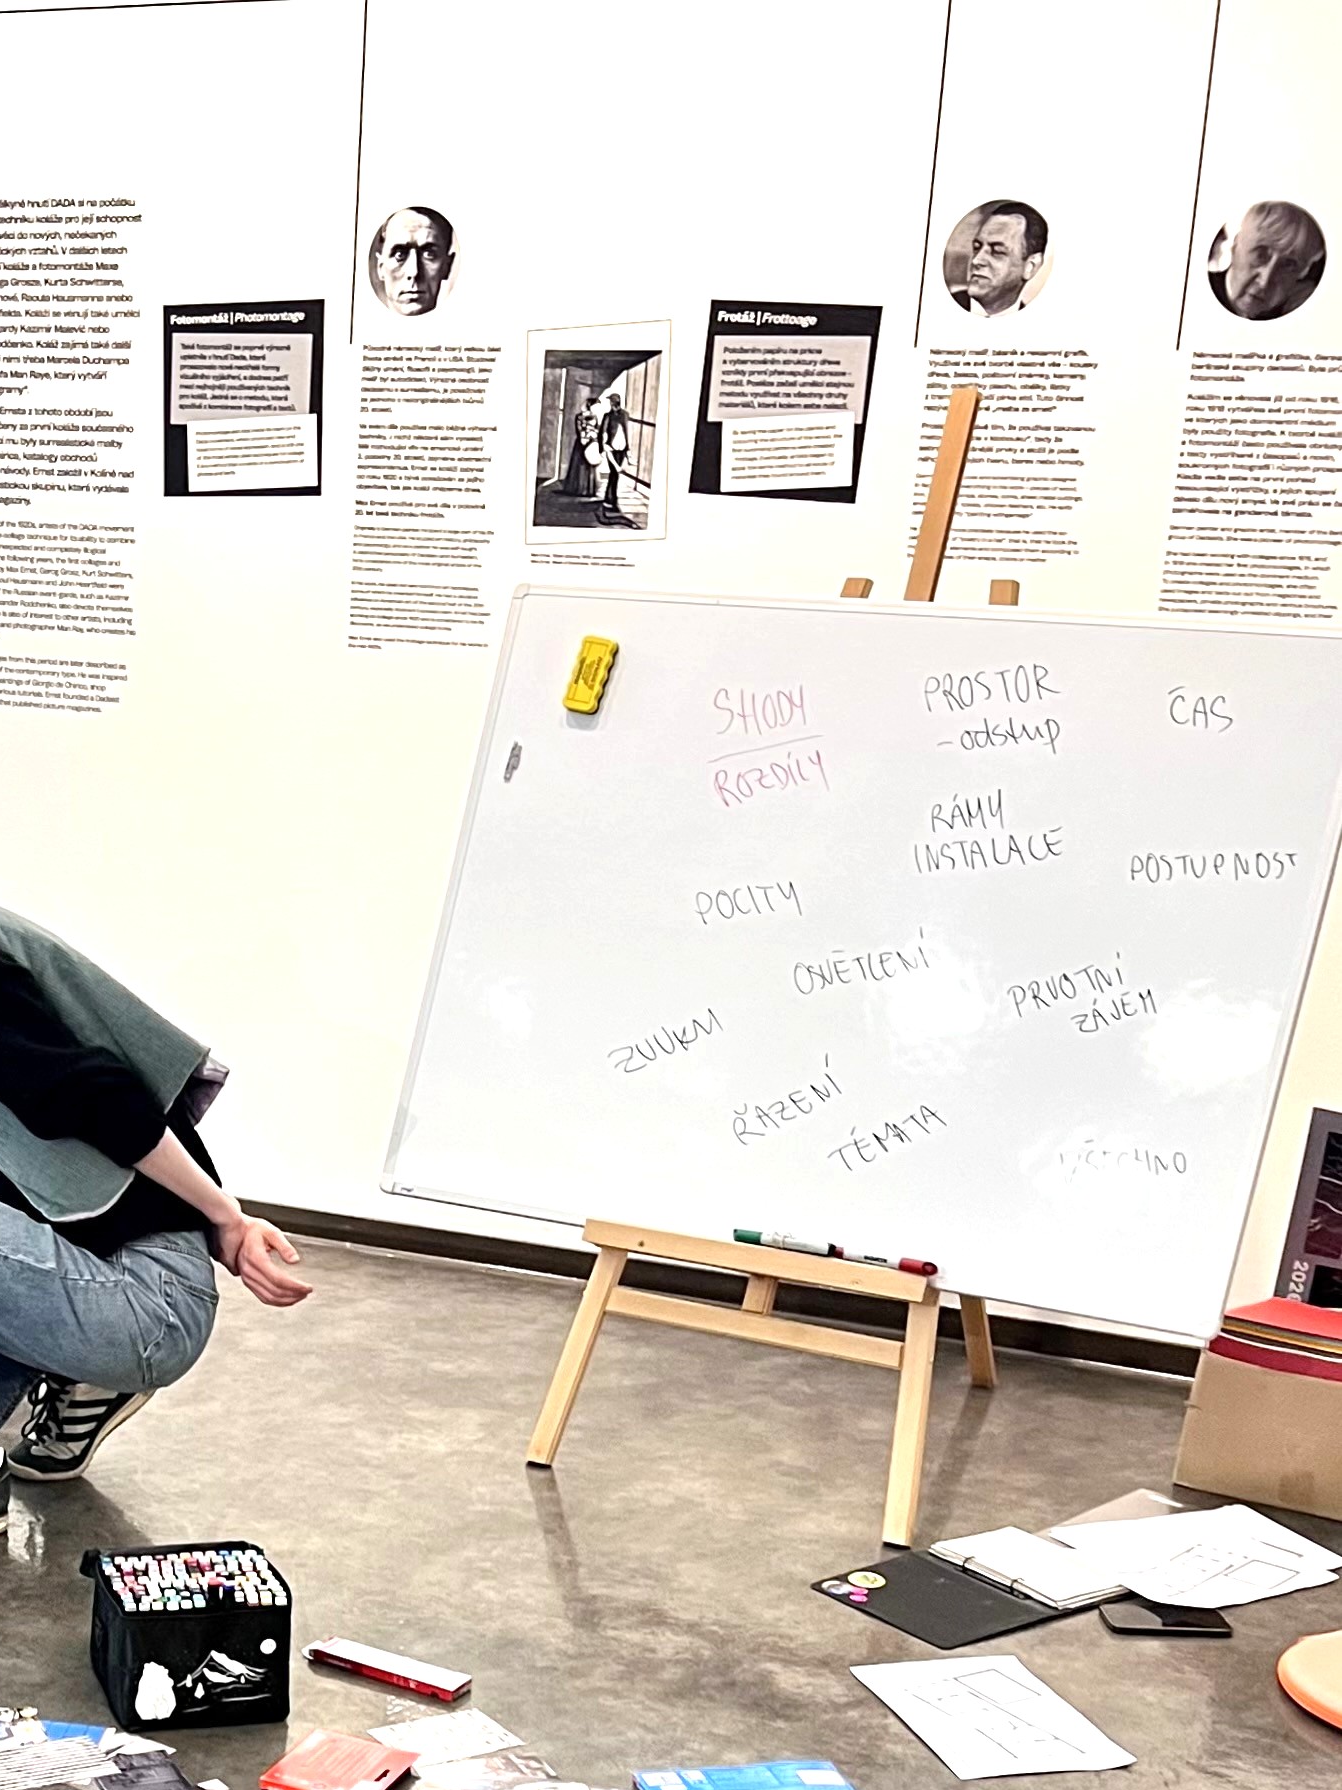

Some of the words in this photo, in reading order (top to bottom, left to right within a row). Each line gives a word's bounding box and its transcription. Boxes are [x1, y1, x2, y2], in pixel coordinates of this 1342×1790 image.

[51, 199, 75, 207] DADA
[234, 312, 305, 323] Photomontage
[713, 684, 807, 735] SHODY
[924, 664, 1062, 712] PROSTOR
[1167, 686, 1234, 733] ČAS
[713, 750, 830, 807] ROZDÍLY
[931, 788, 1004, 833] RÁMY
[914, 827, 1063, 874] INSTALACE
[1130, 852, 1298, 883] POSTUPNOST
[695, 881, 803, 925] POCITY
[1007, 952, 1123, 1018] PRVOTNÍ
[1070, 988, 1158, 1033] ZÁJEM
[733, 1053, 843, 1145] ŘAZENÍ
[828, 1105, 948, 1171] TÉMATA
